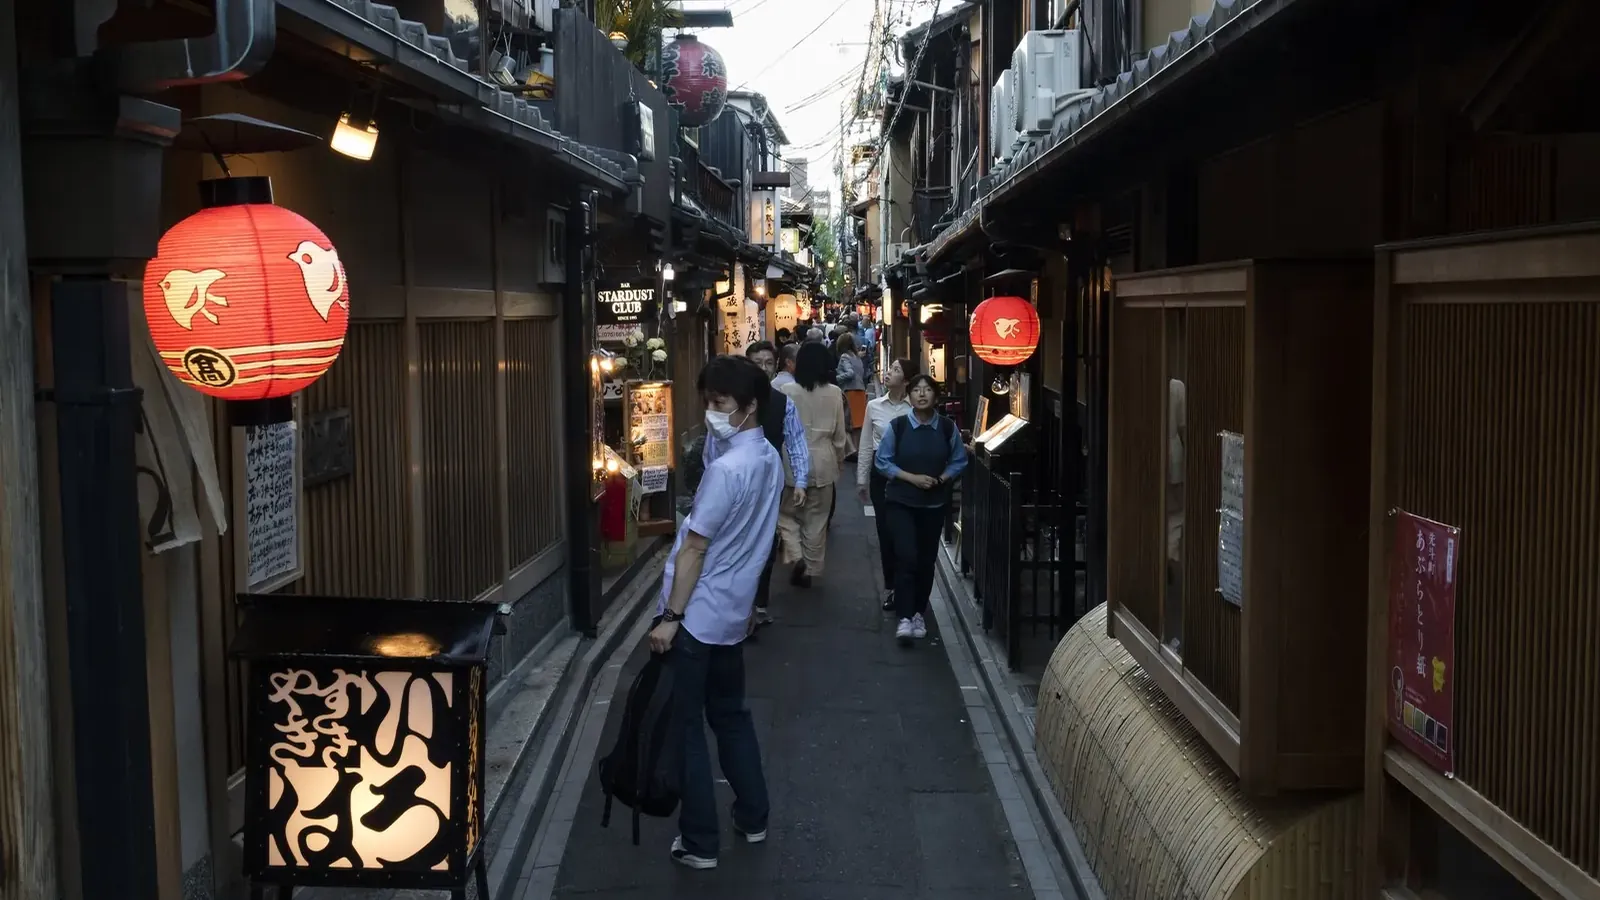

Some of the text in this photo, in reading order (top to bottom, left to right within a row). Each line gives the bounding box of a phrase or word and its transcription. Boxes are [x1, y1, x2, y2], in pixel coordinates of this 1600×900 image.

[597, 289, 655, 303] STARDUST
[611, 301, 642, 314] CLUB
[1415, 528, 1427, 679] あぶらとり紙
